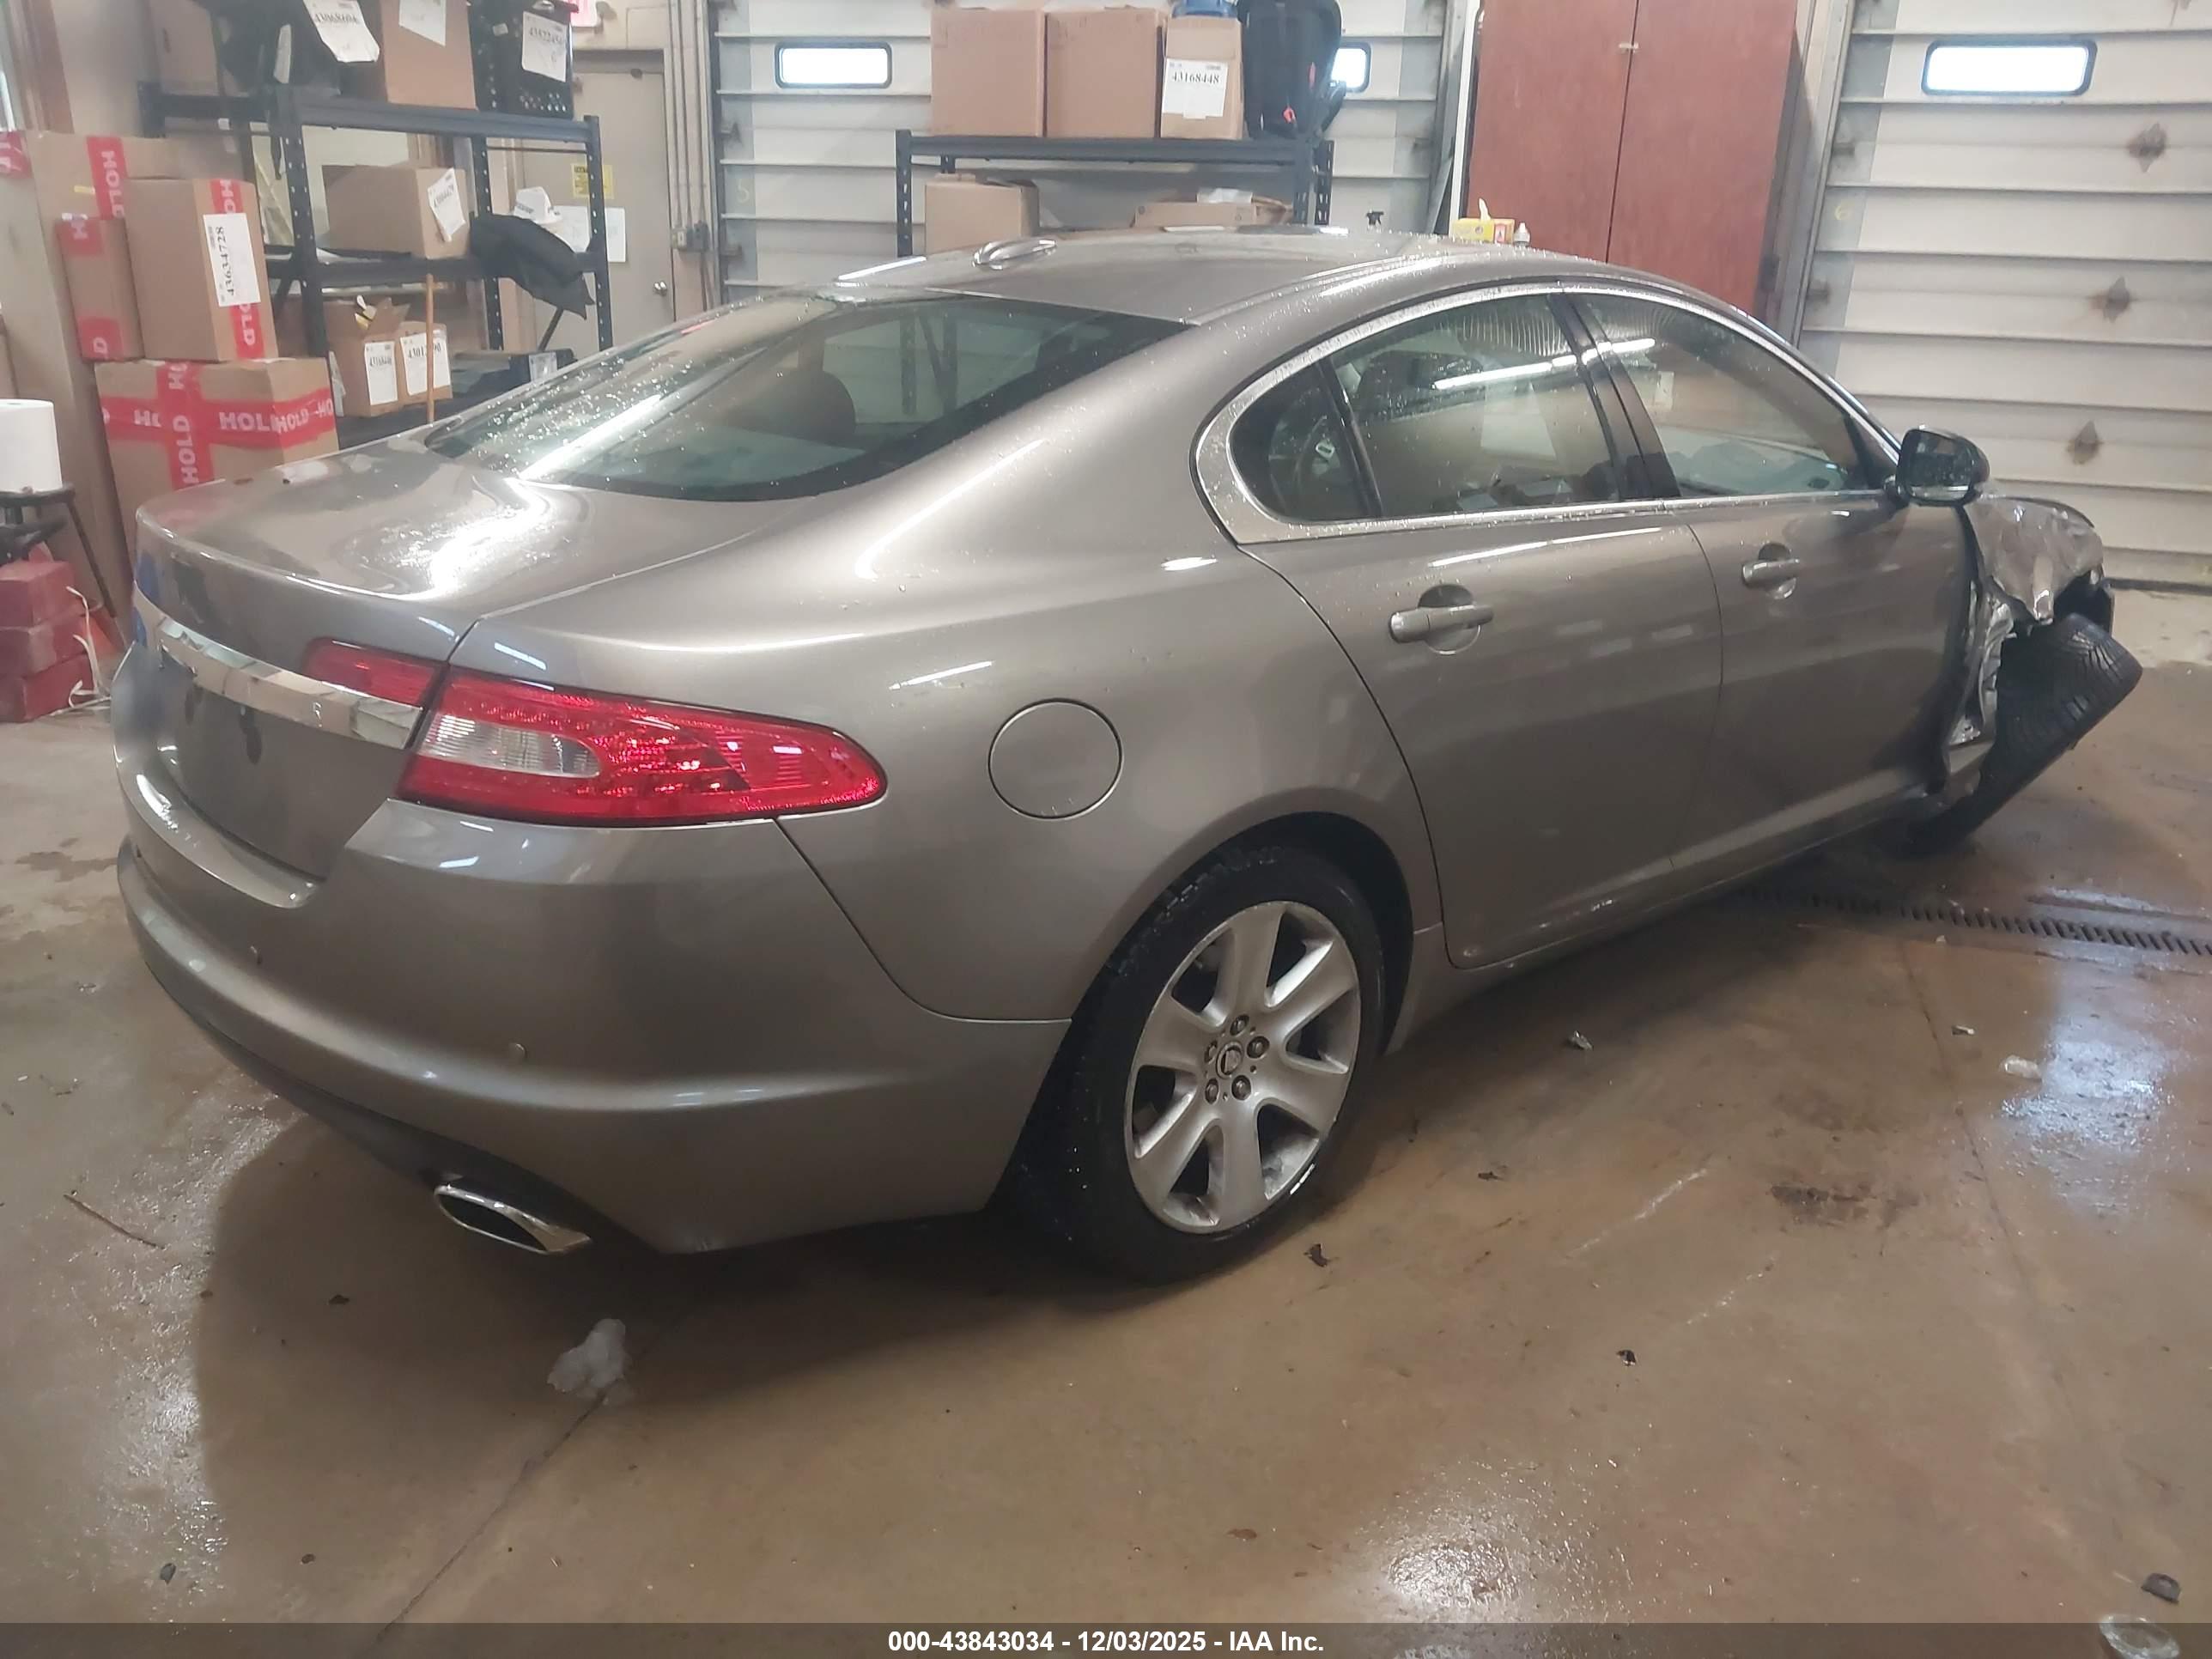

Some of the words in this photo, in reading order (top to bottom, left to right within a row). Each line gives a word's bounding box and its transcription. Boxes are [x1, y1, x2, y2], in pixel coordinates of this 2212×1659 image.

[1172, 70, 1220, 84] 43168448
[216, 225, 234, 296] 43634728
[275, 408, 309, 434] HOLD
[172, 415, 199, 483] HOLD
